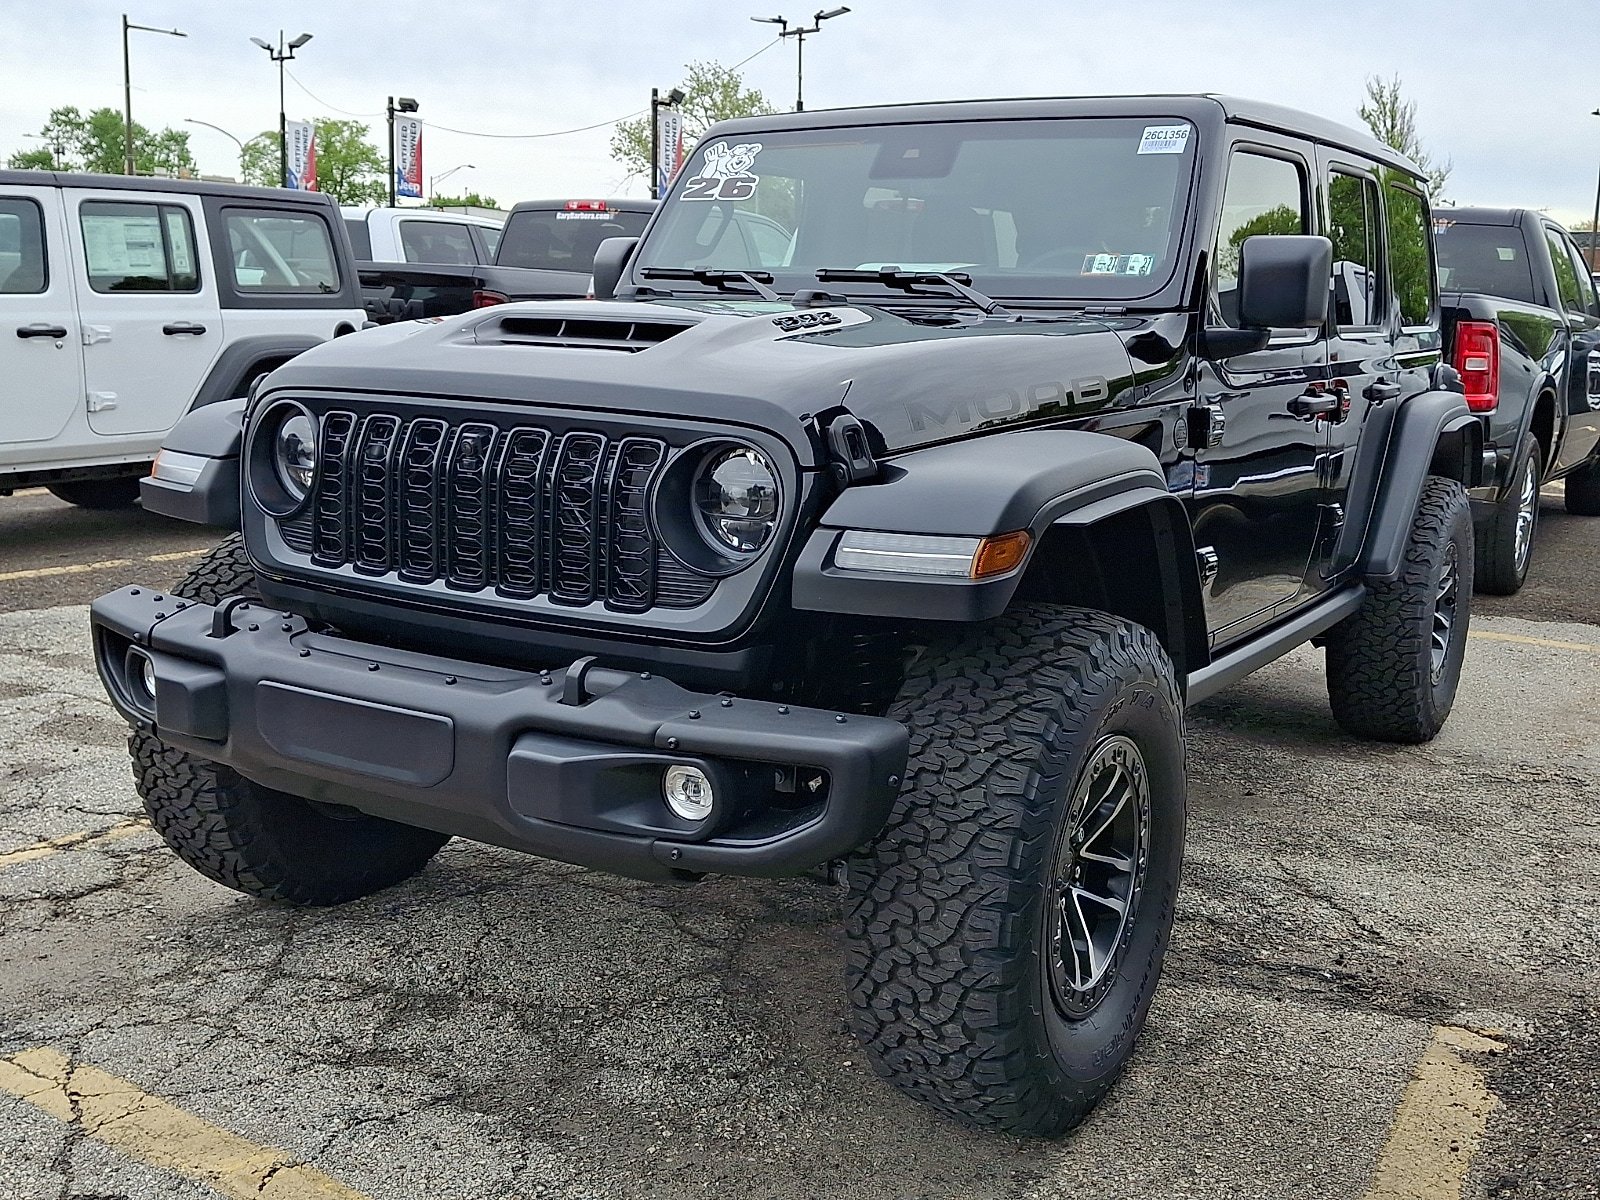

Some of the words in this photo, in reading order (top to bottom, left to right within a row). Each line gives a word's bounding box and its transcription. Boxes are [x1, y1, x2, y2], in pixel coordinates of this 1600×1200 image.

[1144, 130, 1188, 140] 26C1356
[399, 178, 420, 194] Jeep
[680, 176, 759, 201] 26
[1107, 256, 1118, 272] 27
[1140, 256, 1153, 272] 27
[362, 297, 424, 318] AM
[772, 311, 842, 332] 392
[903, 375, 1109, 433] MOAB
